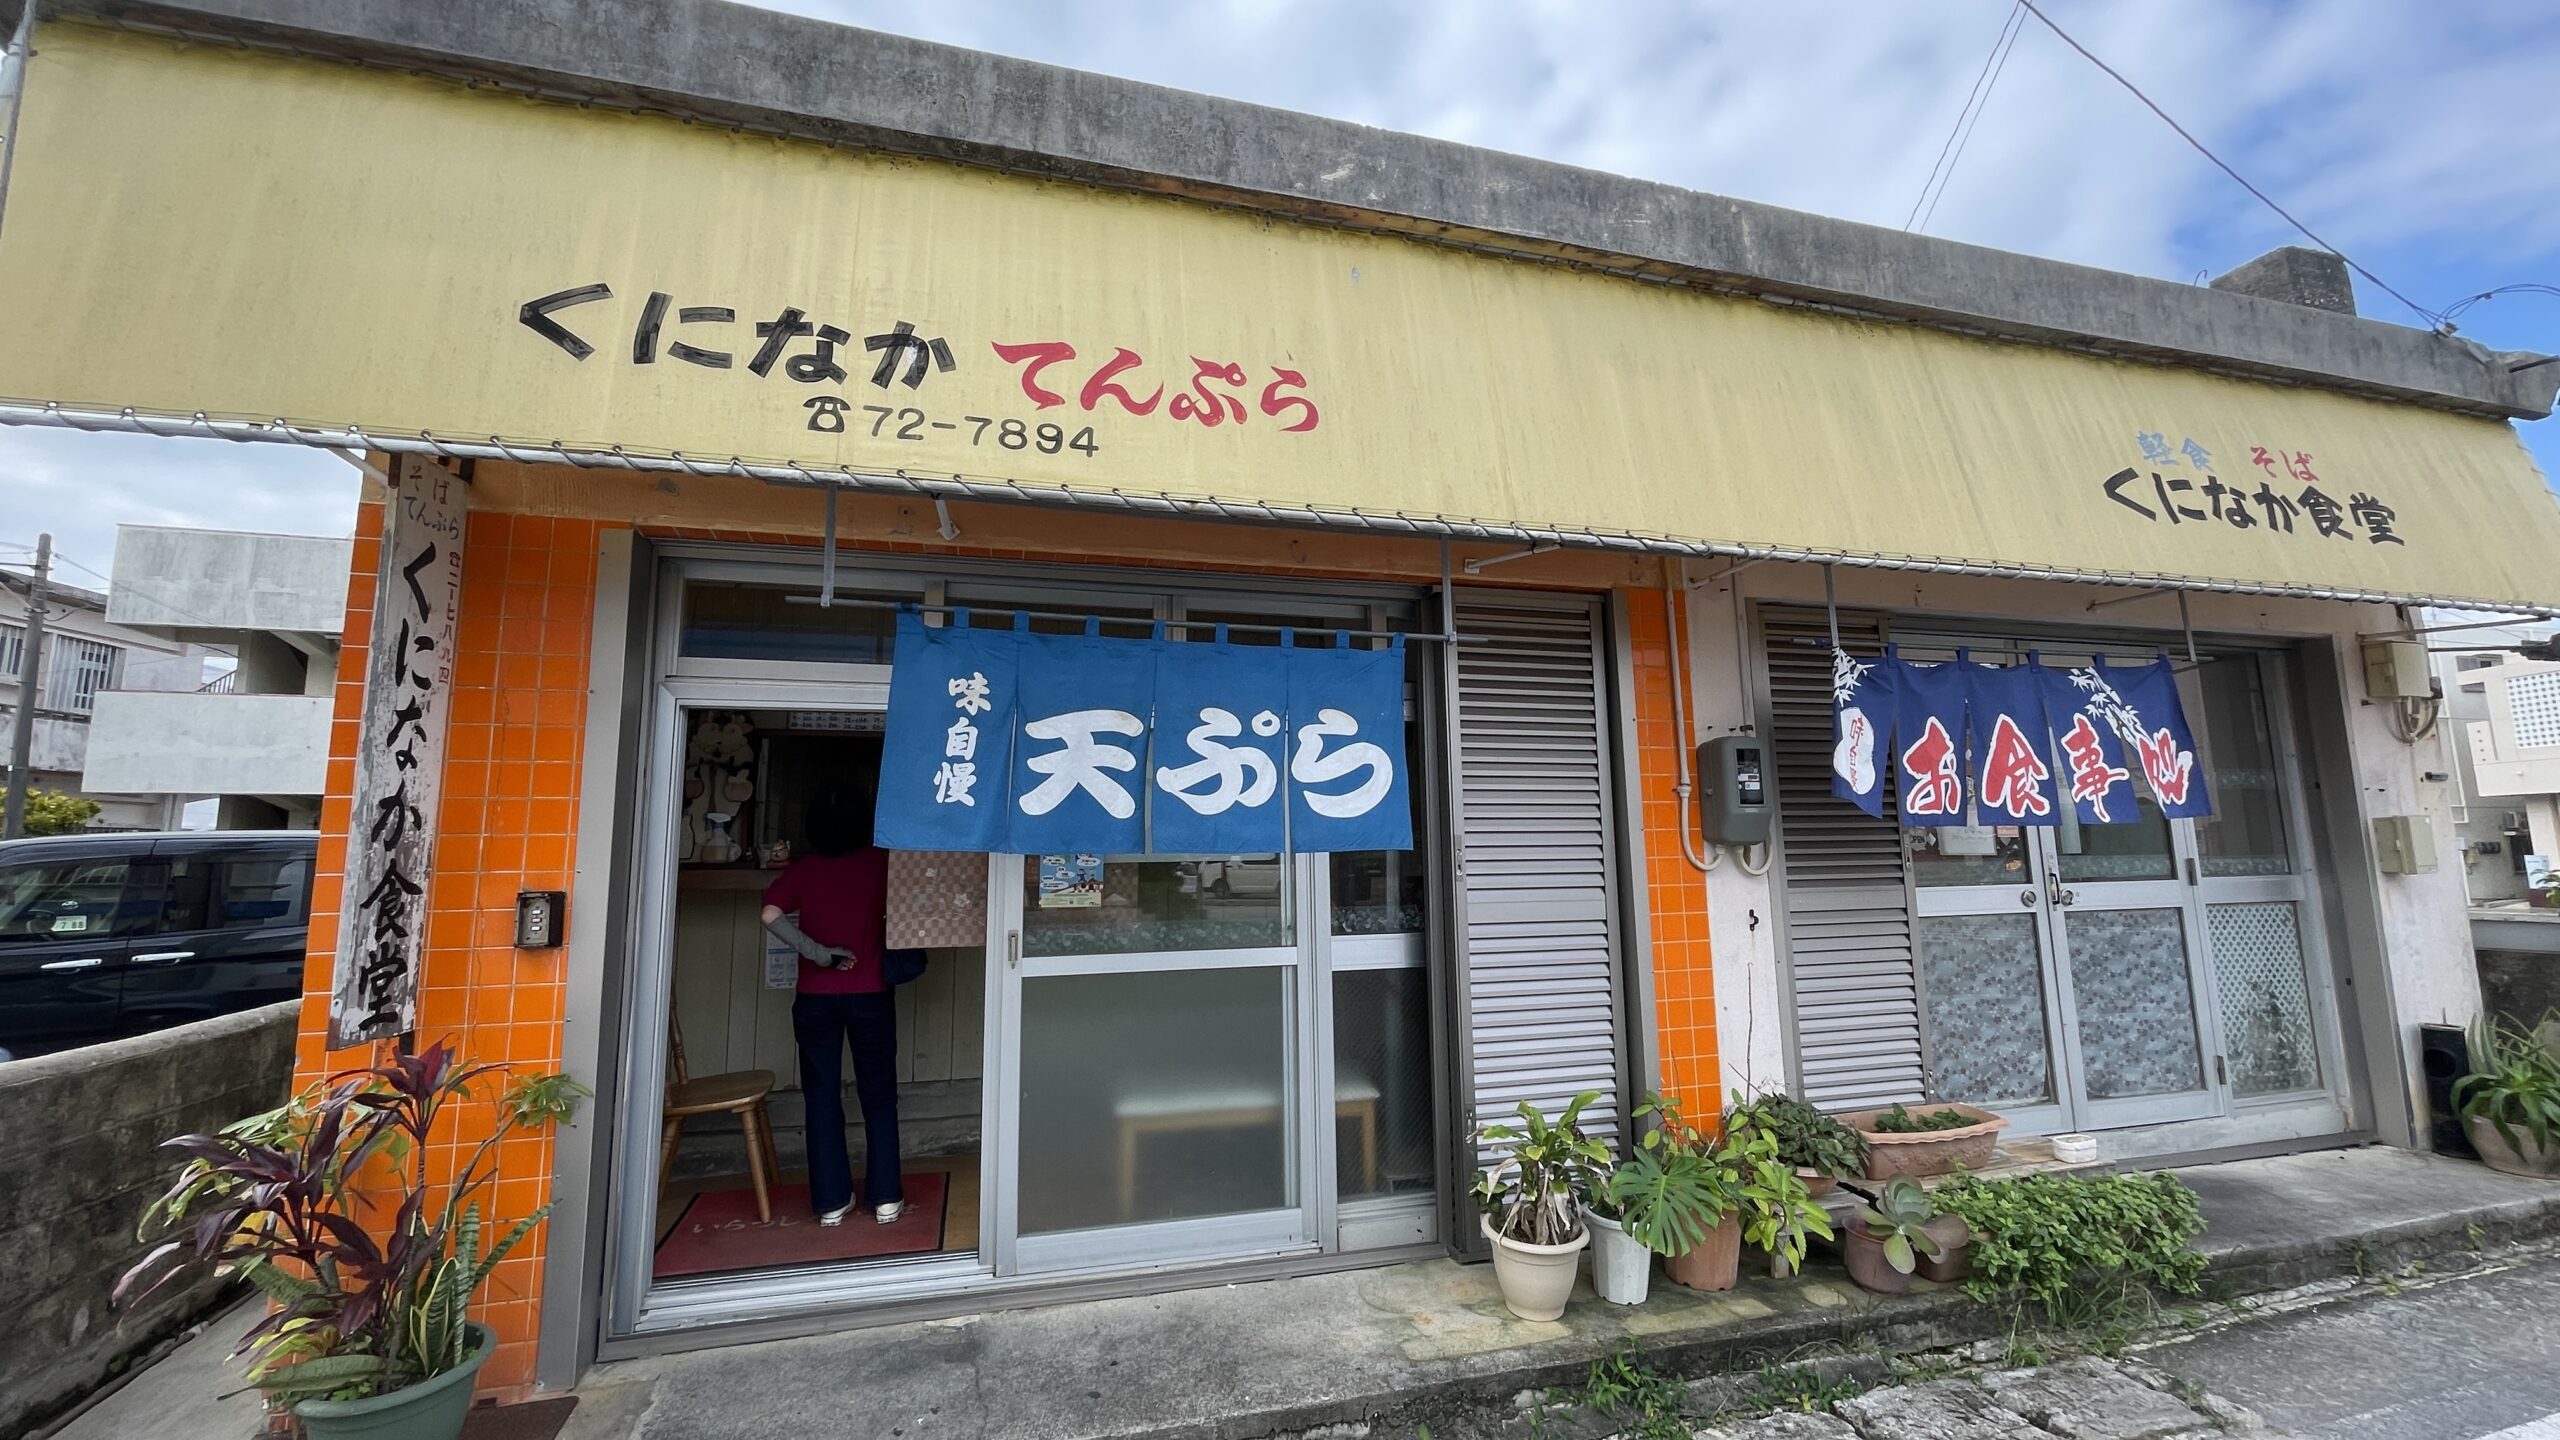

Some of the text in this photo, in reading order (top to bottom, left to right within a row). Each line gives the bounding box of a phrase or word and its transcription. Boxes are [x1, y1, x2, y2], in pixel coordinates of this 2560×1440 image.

[519, 283, 1320, 433] くになか てんぷら
[409, 465, 450, 505] そば
[2102, 467, 2405, 547] くになか食堂
[2136, 430, 2320, 482] 軽食 そば
[358, 541, 437, 1031] くになか食堂
[933, 671, 992, 808] 味自慢
[1018, 707, 1394, 820] 天ぷら
